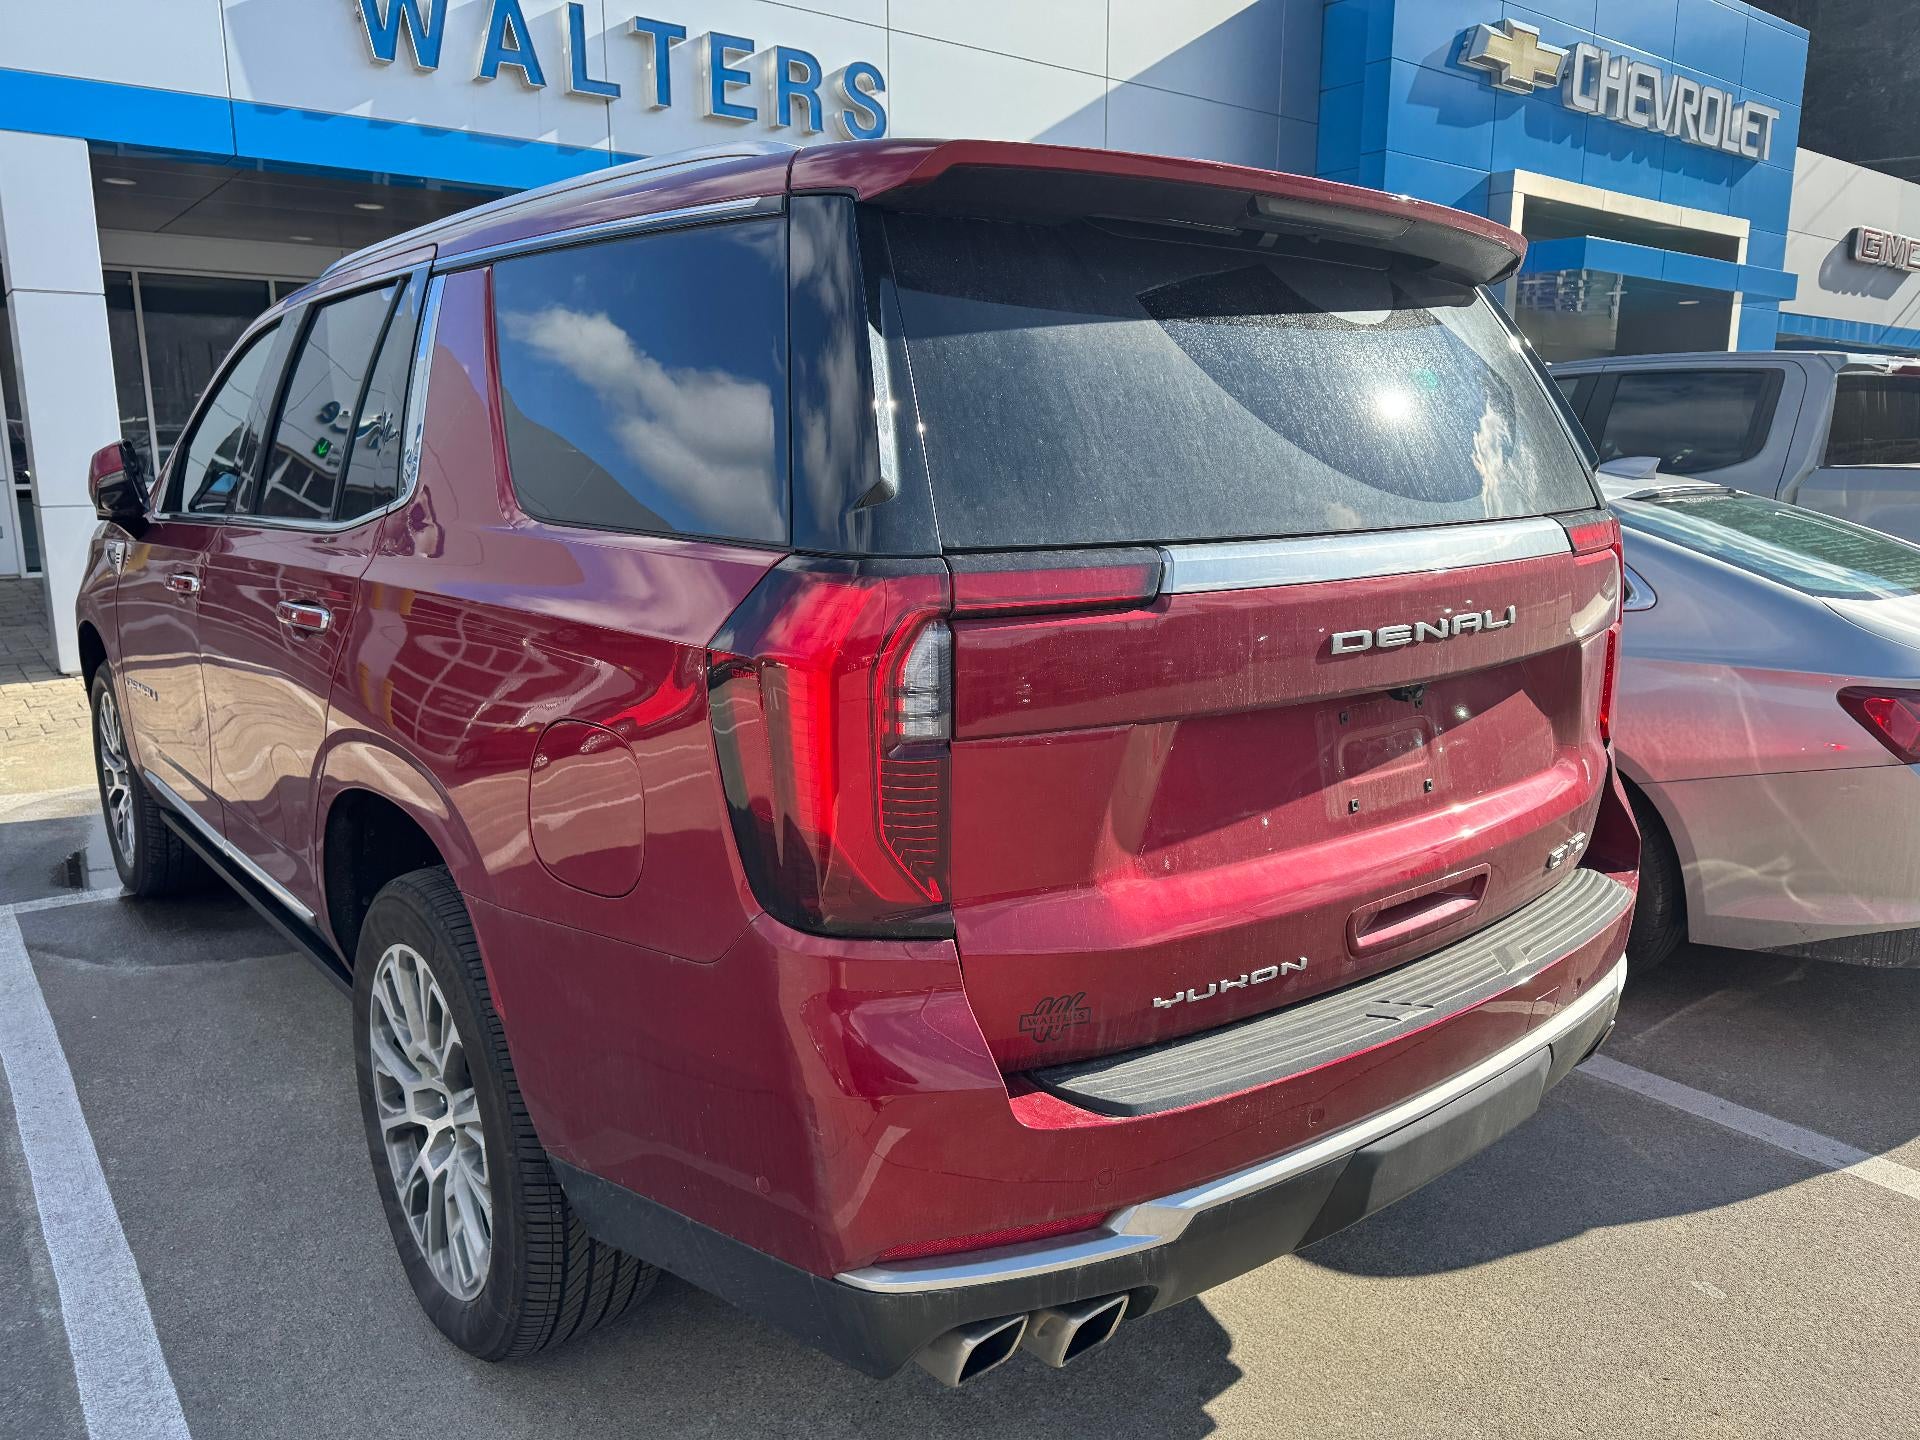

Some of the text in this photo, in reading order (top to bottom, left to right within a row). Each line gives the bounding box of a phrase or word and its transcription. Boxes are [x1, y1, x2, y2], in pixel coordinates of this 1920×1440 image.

[352, 0, 887, 139] WALTERS
[1570, 41, 1780, 161] CHEVROLET
[1331, 604, 1516, 655] DENALI
[1153, 956, 1308, 1008] YUKON
